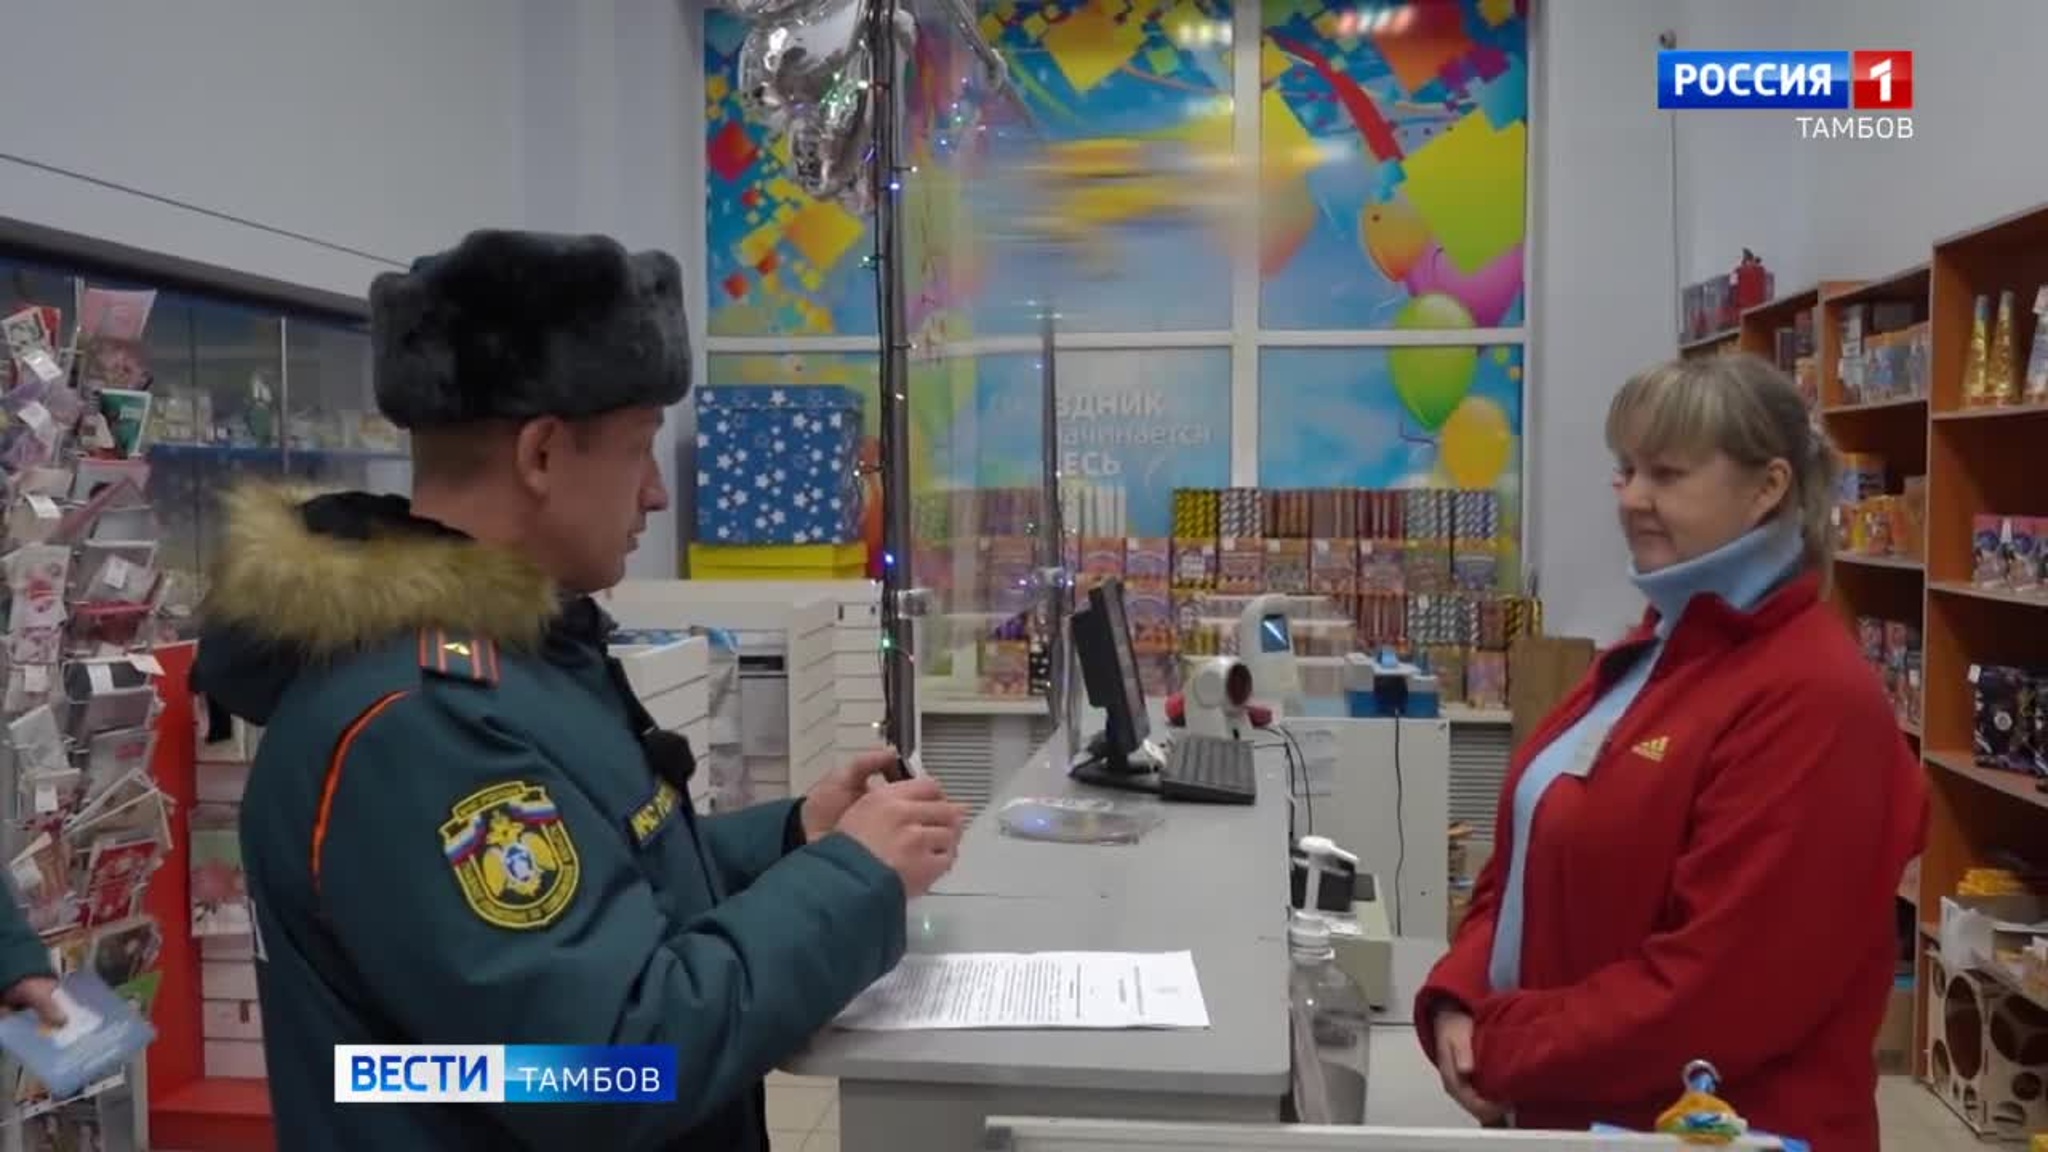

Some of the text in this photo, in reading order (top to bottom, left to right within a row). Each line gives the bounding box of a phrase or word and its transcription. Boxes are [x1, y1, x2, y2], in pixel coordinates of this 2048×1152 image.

[1055, 390, 1168, 421] ЗДНИК
[1057, 423, 1212, 447] ачинается
[1060, 451, 1122, 476] ЕСЬ
